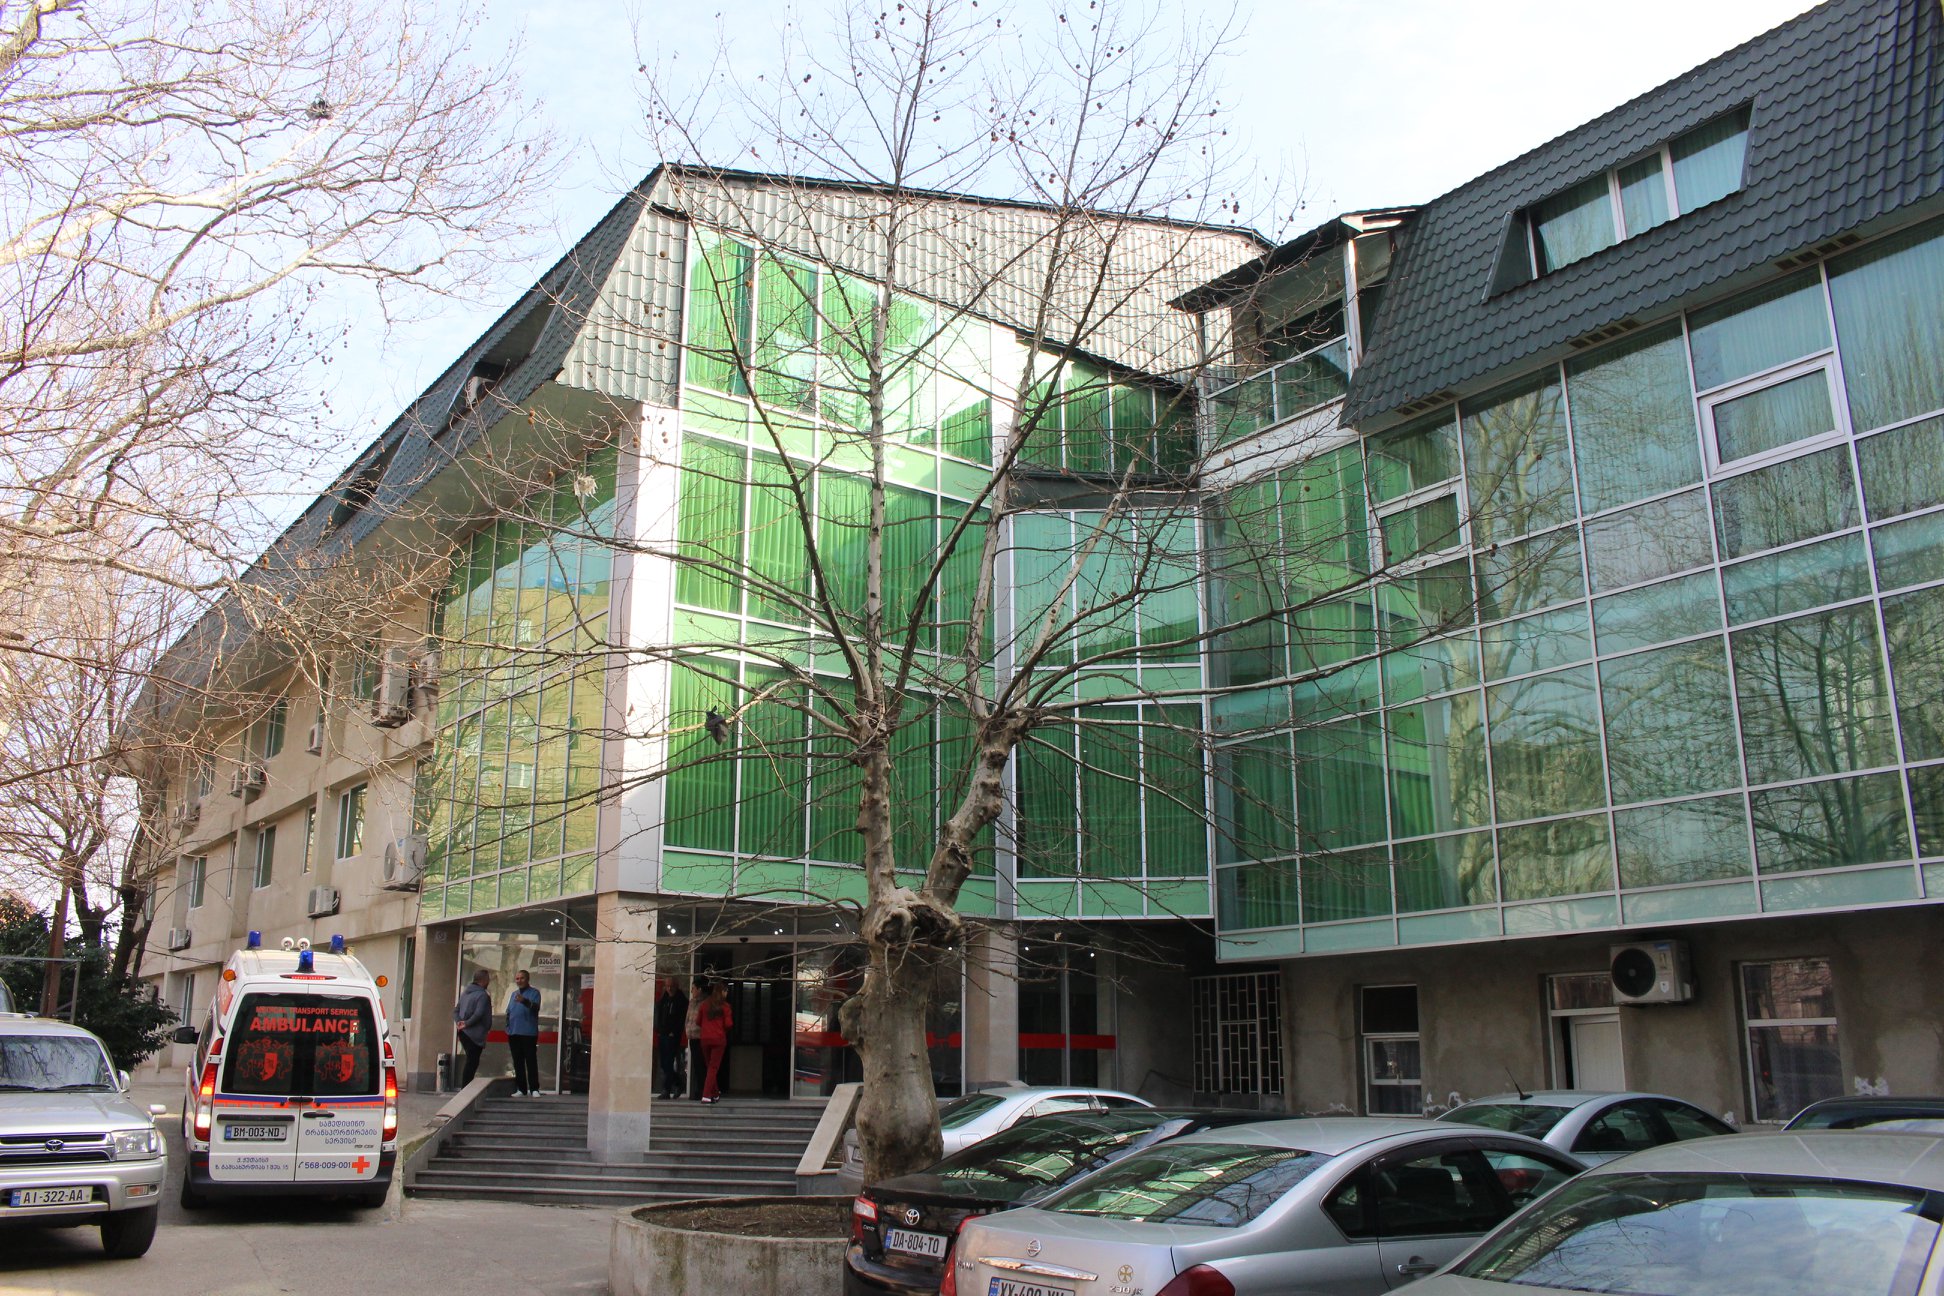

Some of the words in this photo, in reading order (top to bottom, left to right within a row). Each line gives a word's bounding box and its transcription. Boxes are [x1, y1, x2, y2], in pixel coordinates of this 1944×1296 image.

[289, 1007, 329, 1015] TRANSPORT
[330, 1008, 358, 1016] SERVICE
[249, 1017, 360, 1033] AMBULANCE
[233, 1127, 280, 1137] BM-003-ND
[304, 1161, 351, 1169] 568-009-001
[23, 1189, 83, 1204] AI-322-AA
[892, 1231, 940, 1254] DA-804-TO
